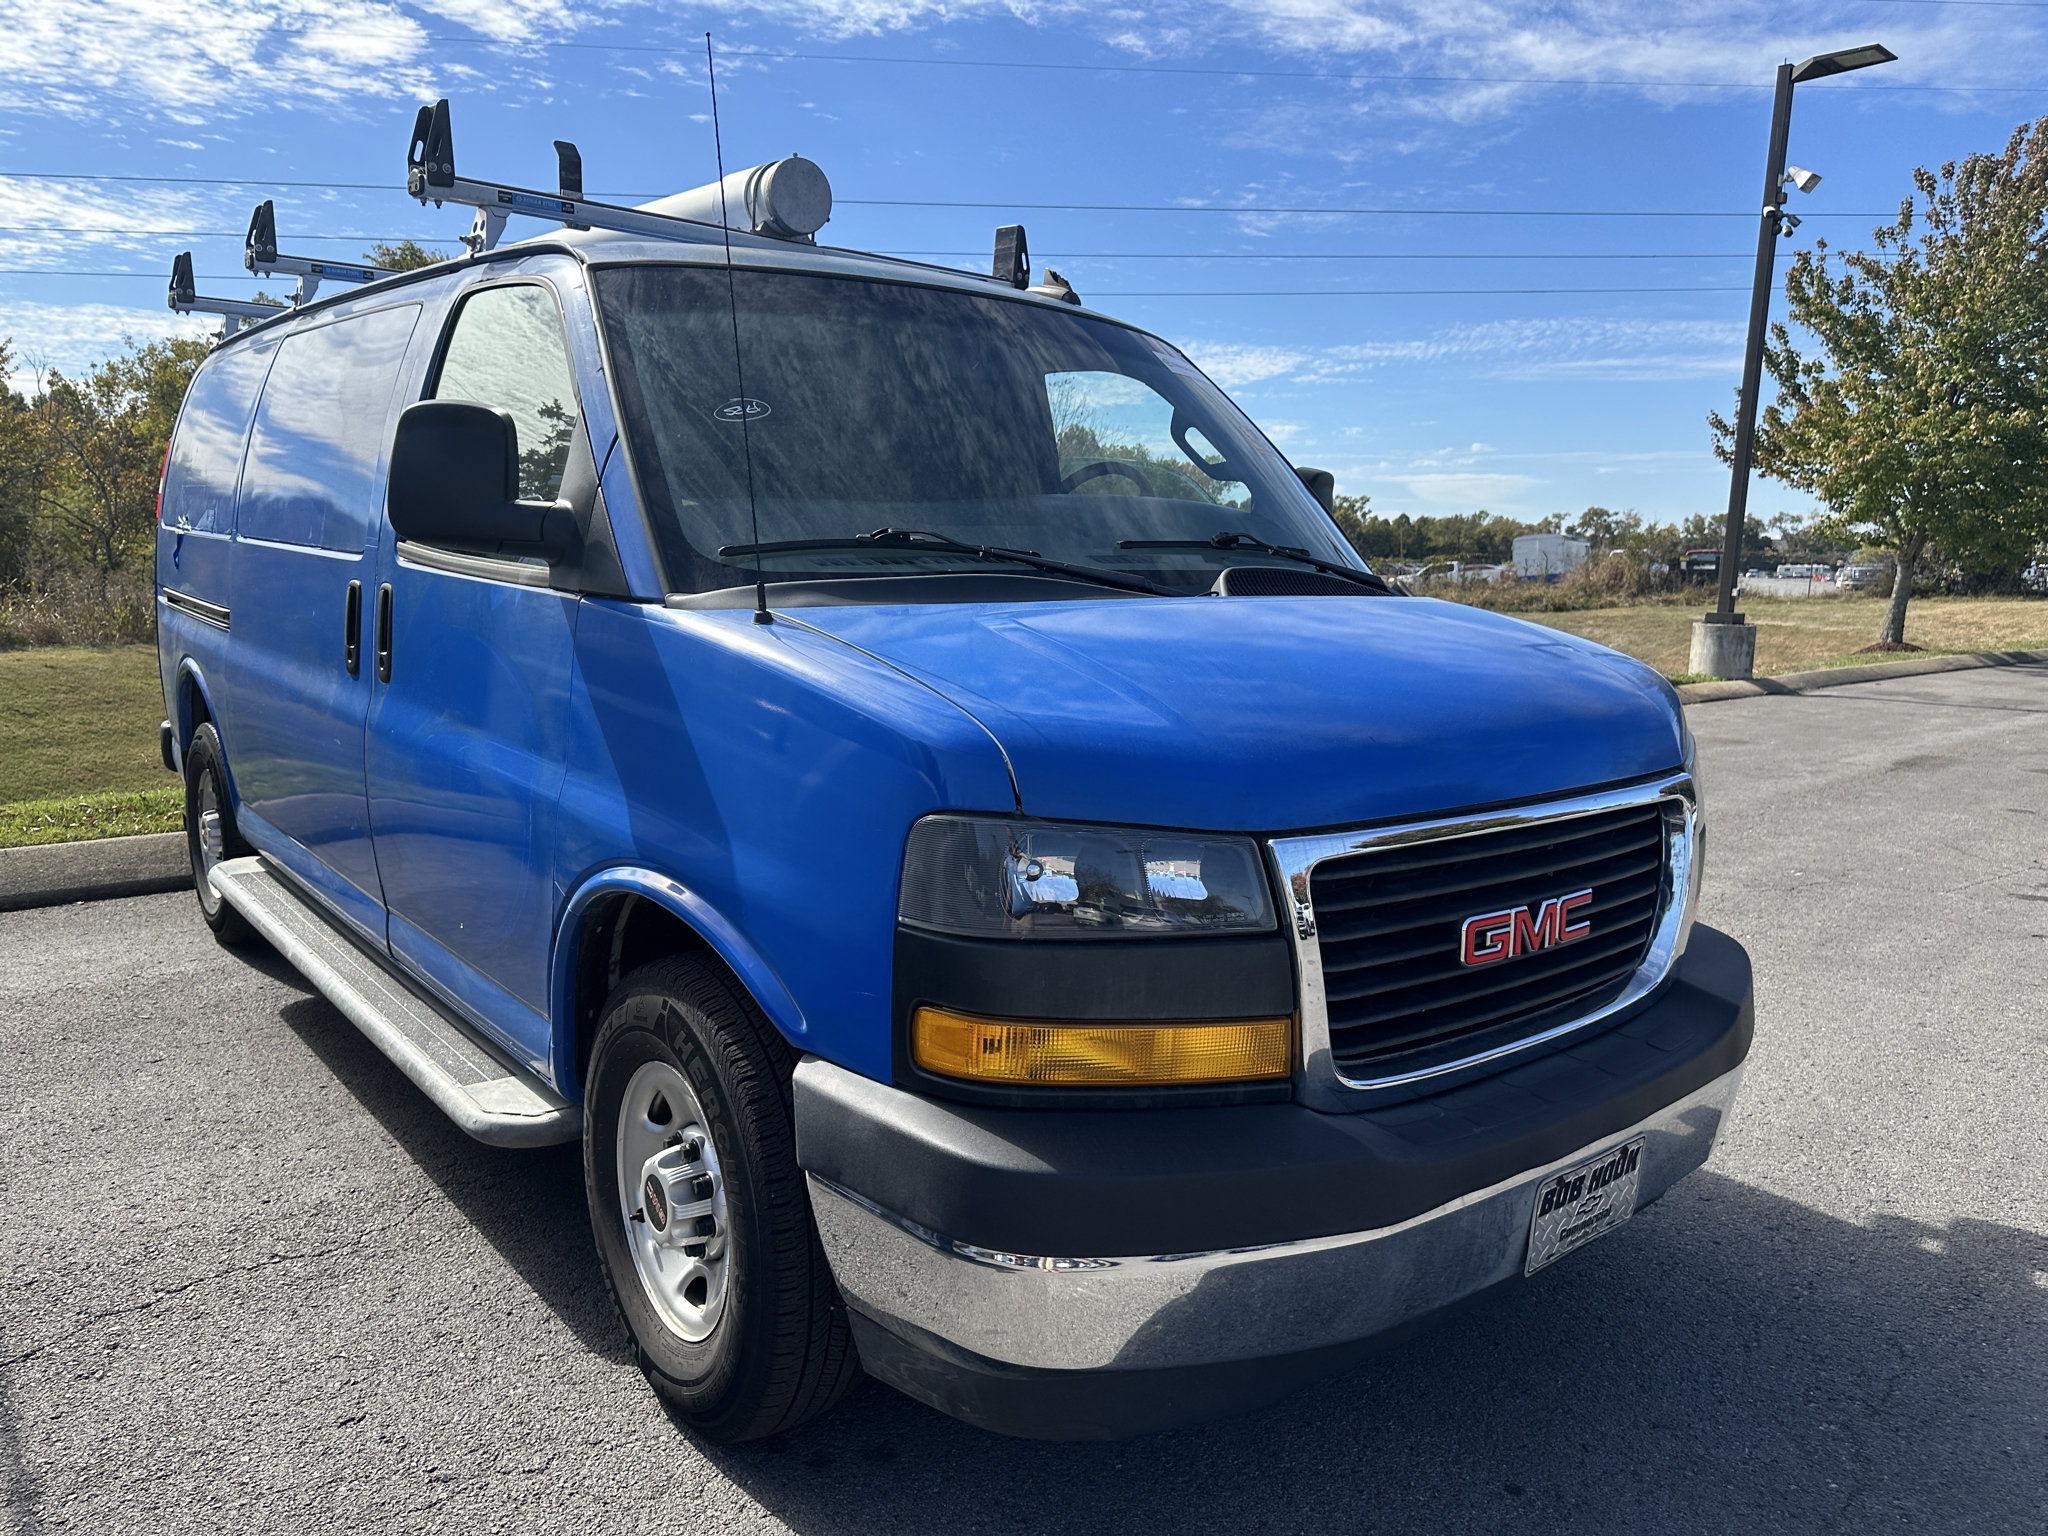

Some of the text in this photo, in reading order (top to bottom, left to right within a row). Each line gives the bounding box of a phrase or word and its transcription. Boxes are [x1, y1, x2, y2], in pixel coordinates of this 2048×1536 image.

[1460, 888, 1592, 966] GMC
[1538, 1145, 1642, 1218] BOB HOOK
